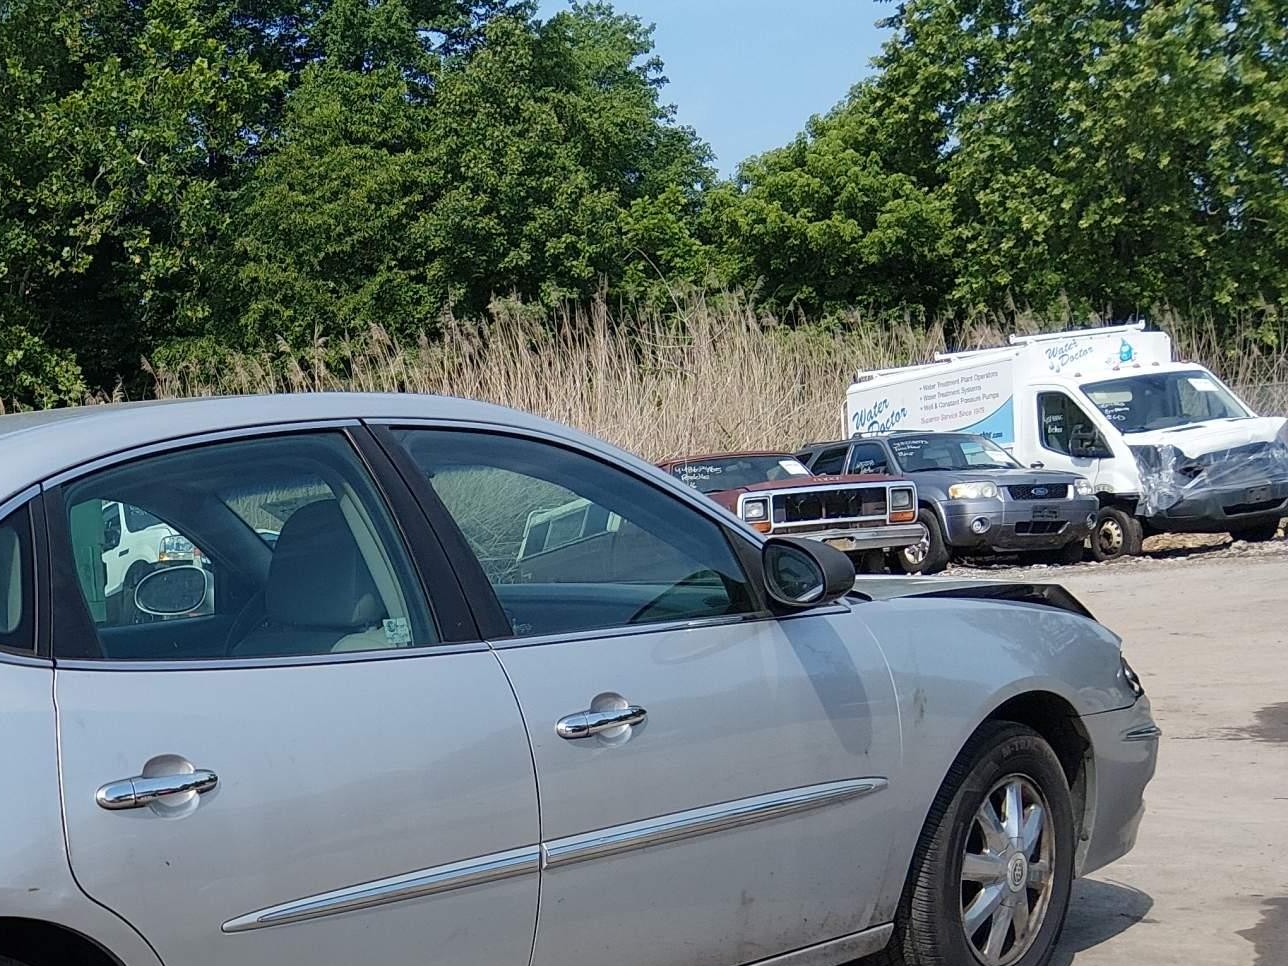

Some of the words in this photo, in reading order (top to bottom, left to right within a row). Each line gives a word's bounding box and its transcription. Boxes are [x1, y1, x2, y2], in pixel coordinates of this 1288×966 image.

[1045, 339, 1079, 359] Water
[1059, 347, 1093, 366] Doctor
[923, 383, 936, 391] Water
[937, 379, 960, 388] Treatment
[974, 371, 999, 381] Operators
[937, 389, 960, 398] Treatment
[961, 385, 982, 395] Systems
[938, 399, 960, 408] Constant
[852, 398, 889, 430] Water
[867, 407, 908, 433] Doctor
